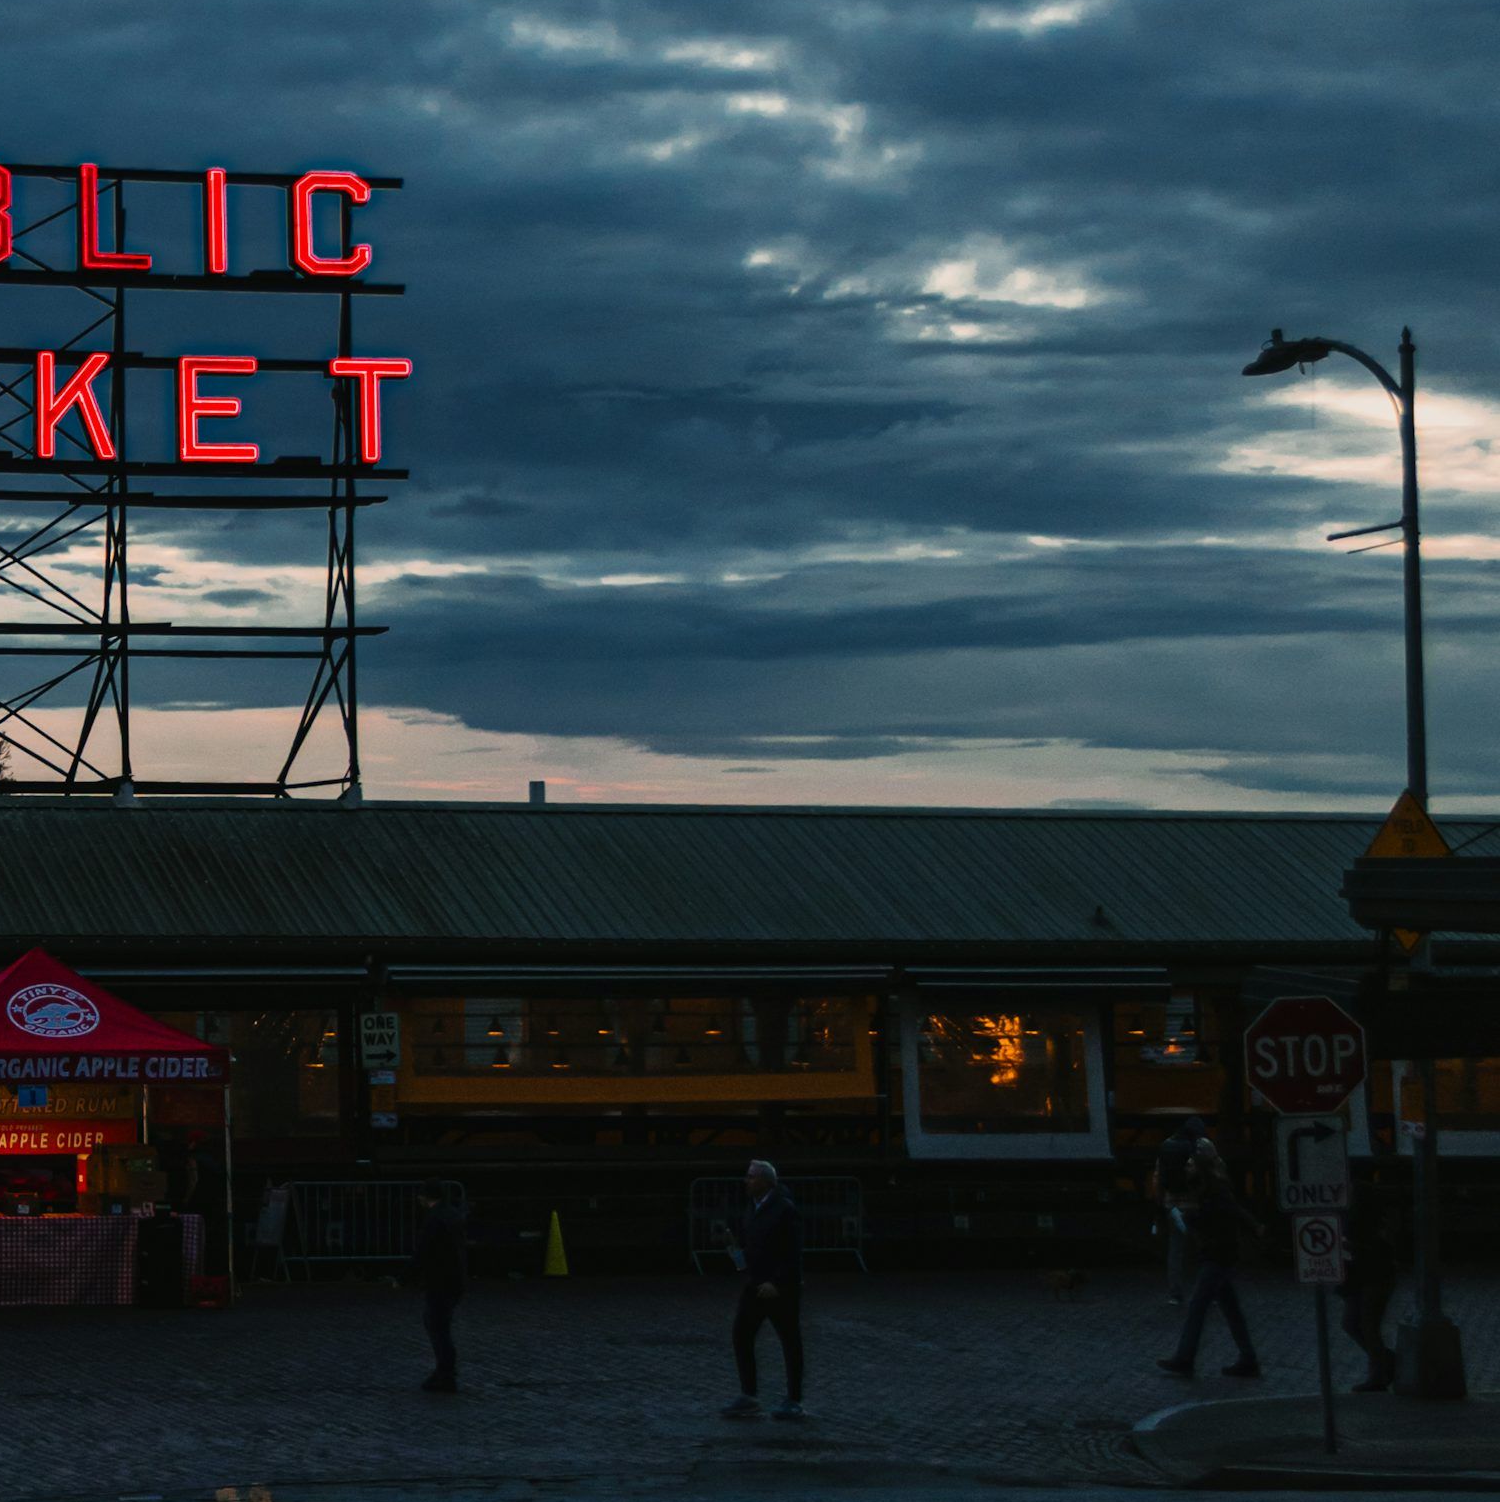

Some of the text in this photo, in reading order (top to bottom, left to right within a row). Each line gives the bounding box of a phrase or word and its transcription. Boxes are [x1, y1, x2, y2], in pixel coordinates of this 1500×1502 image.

[18, 986, 78, 1001] TINY'S
[24, 1022, 90, 1036] ORGANIC
[363, 1017, 395, 1030] ONE
[363, 1031, 396, 1045] WAY
[1254, 1034, 1356, 1078] STOP
[71, 1056, 140, 1078] APPLE
[145, 1056, 210, 1078] CIDER
[75, 1099, 117, 1114] RUM
[56, 1131, 105, 1148] CIDER
[1286, 1184, 1344, 1204] ONLY
